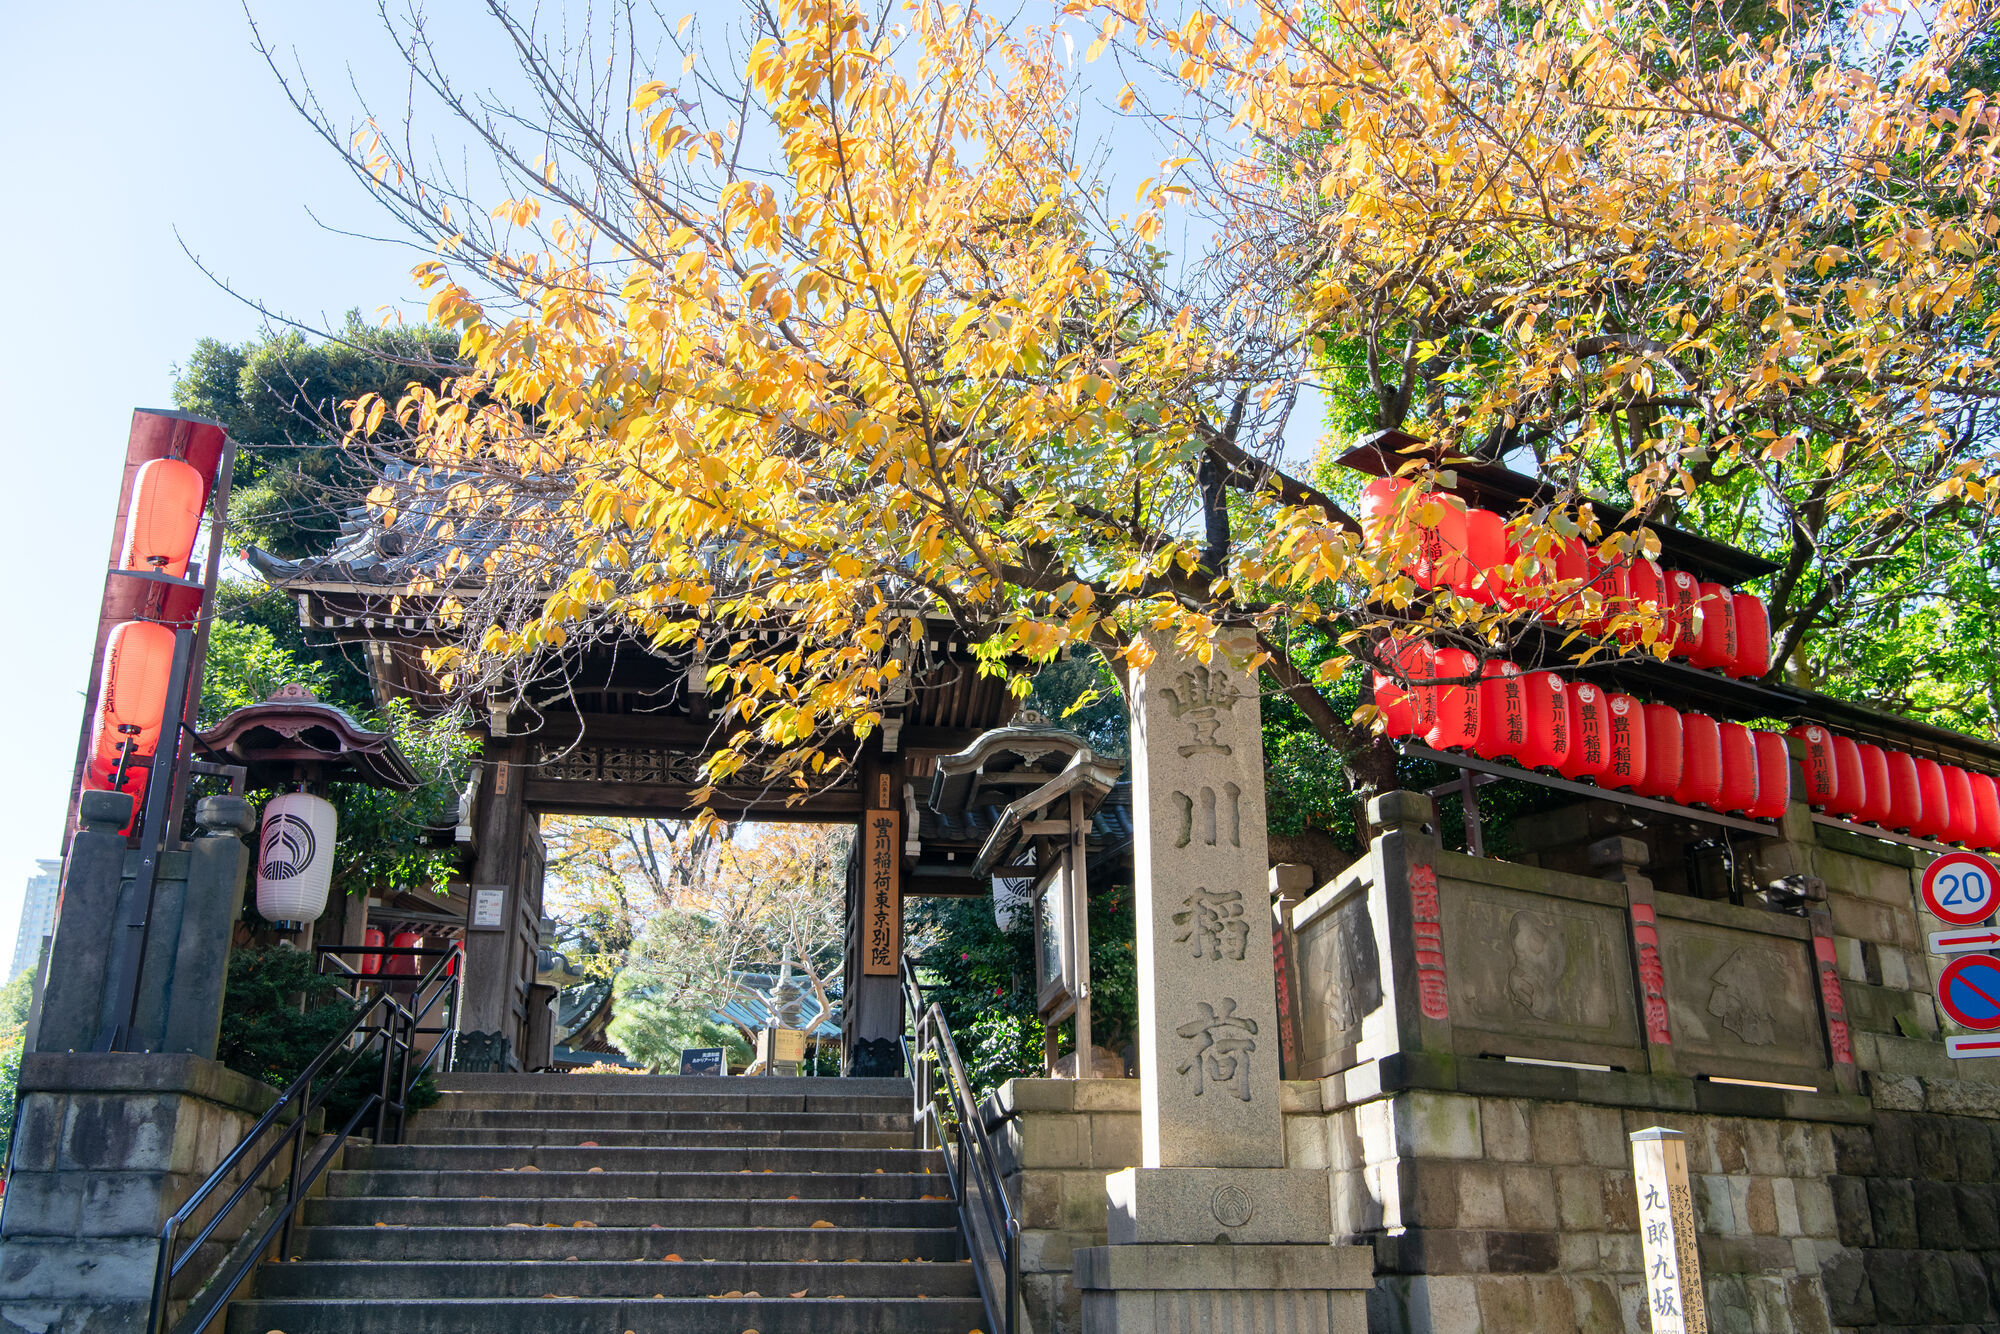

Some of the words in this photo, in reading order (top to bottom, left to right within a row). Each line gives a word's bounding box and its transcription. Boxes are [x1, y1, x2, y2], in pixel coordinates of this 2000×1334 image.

[1678, 589, 1696, 645] 豊川稲荷
[1504, 682, 1524, 745] 豊川稲荷
[1551, 693, 1567, 754] 豊川稲荷
[1581, 704, 1601, 764] 豊川稲荷
[1613, 716, 1631, 776] 豊川稲荷
[1811, 744, 1830, 795] 豊川稲荷
[1938, 871, 1985, 906] 20
[1644, 1183, 1679, 1317] 九郎九坂
